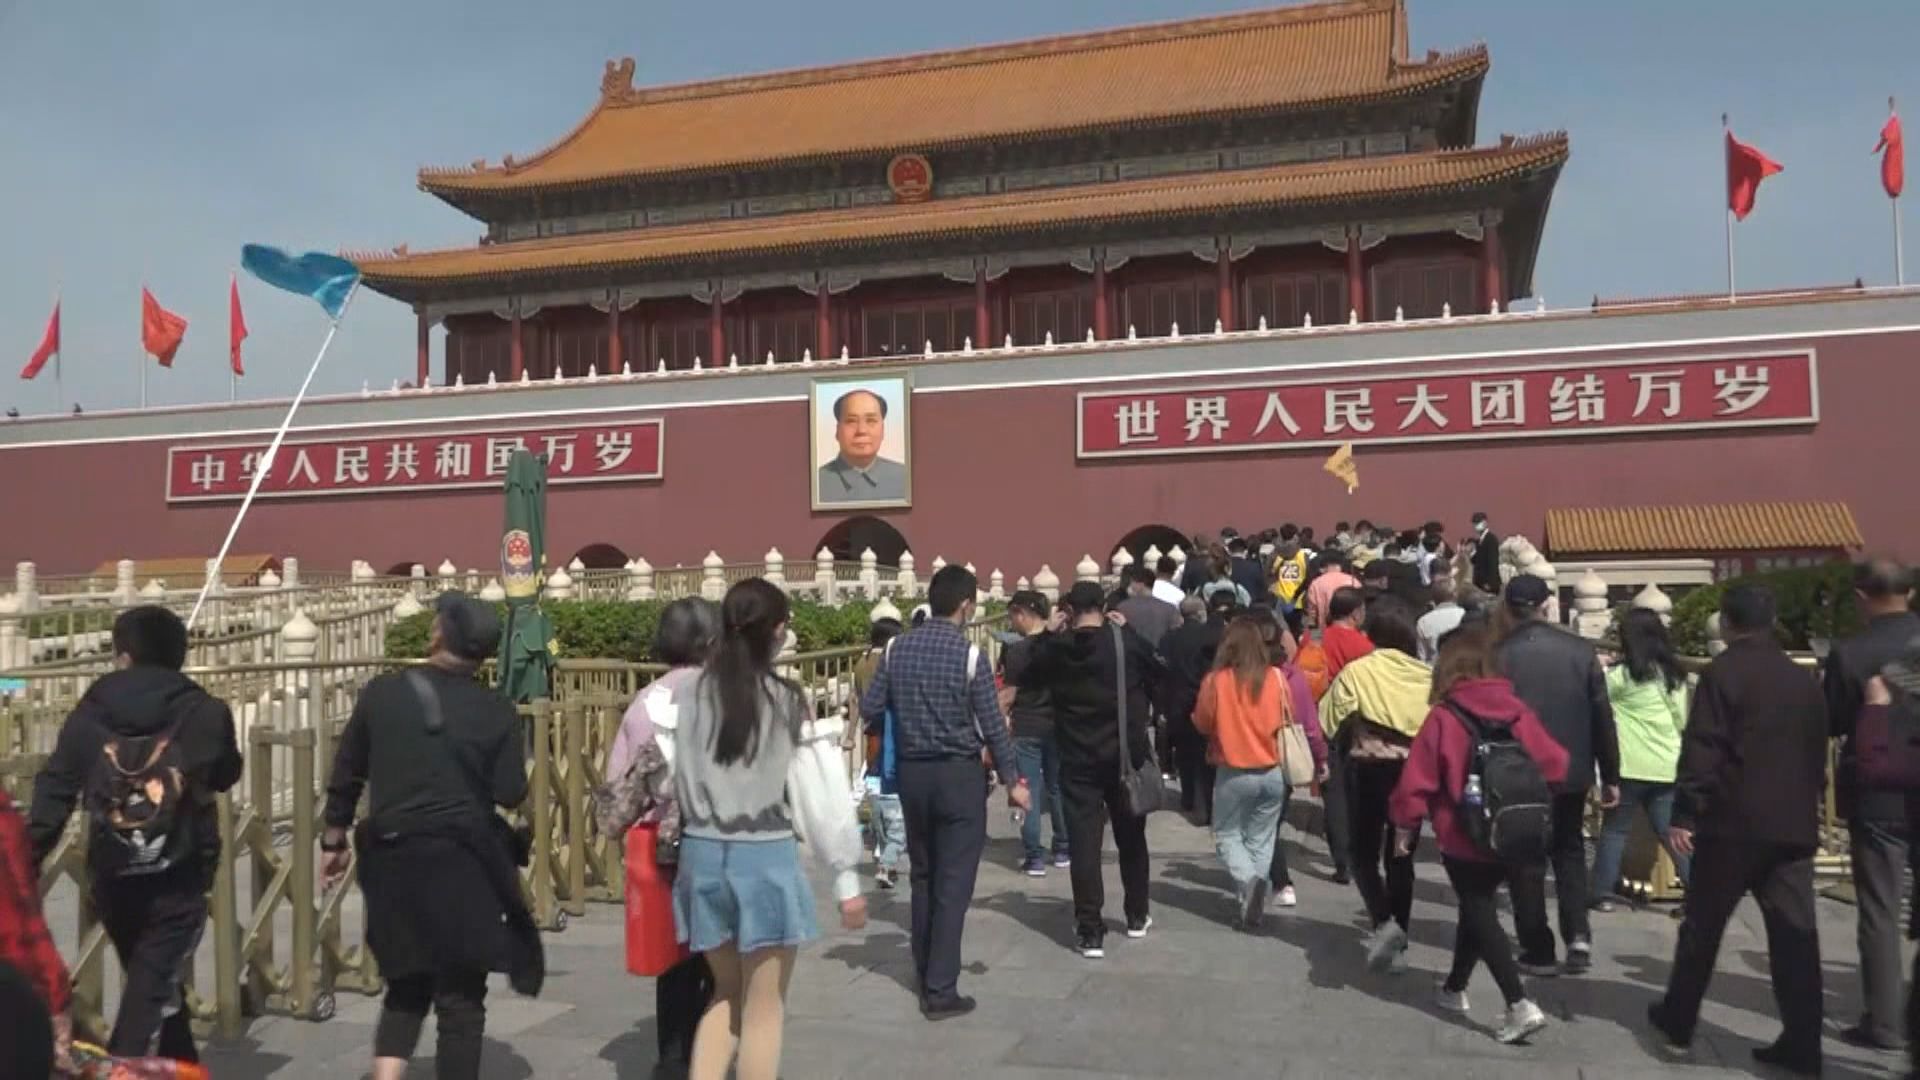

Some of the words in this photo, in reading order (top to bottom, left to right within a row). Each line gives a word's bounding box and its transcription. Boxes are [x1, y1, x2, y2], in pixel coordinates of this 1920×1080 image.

[1114, 365, 1770, 444] 世界人民大团结万岁
[191, 431, 633, 490] 中华人民共和国万岁
[1281, 563, 1300, 580] 23
